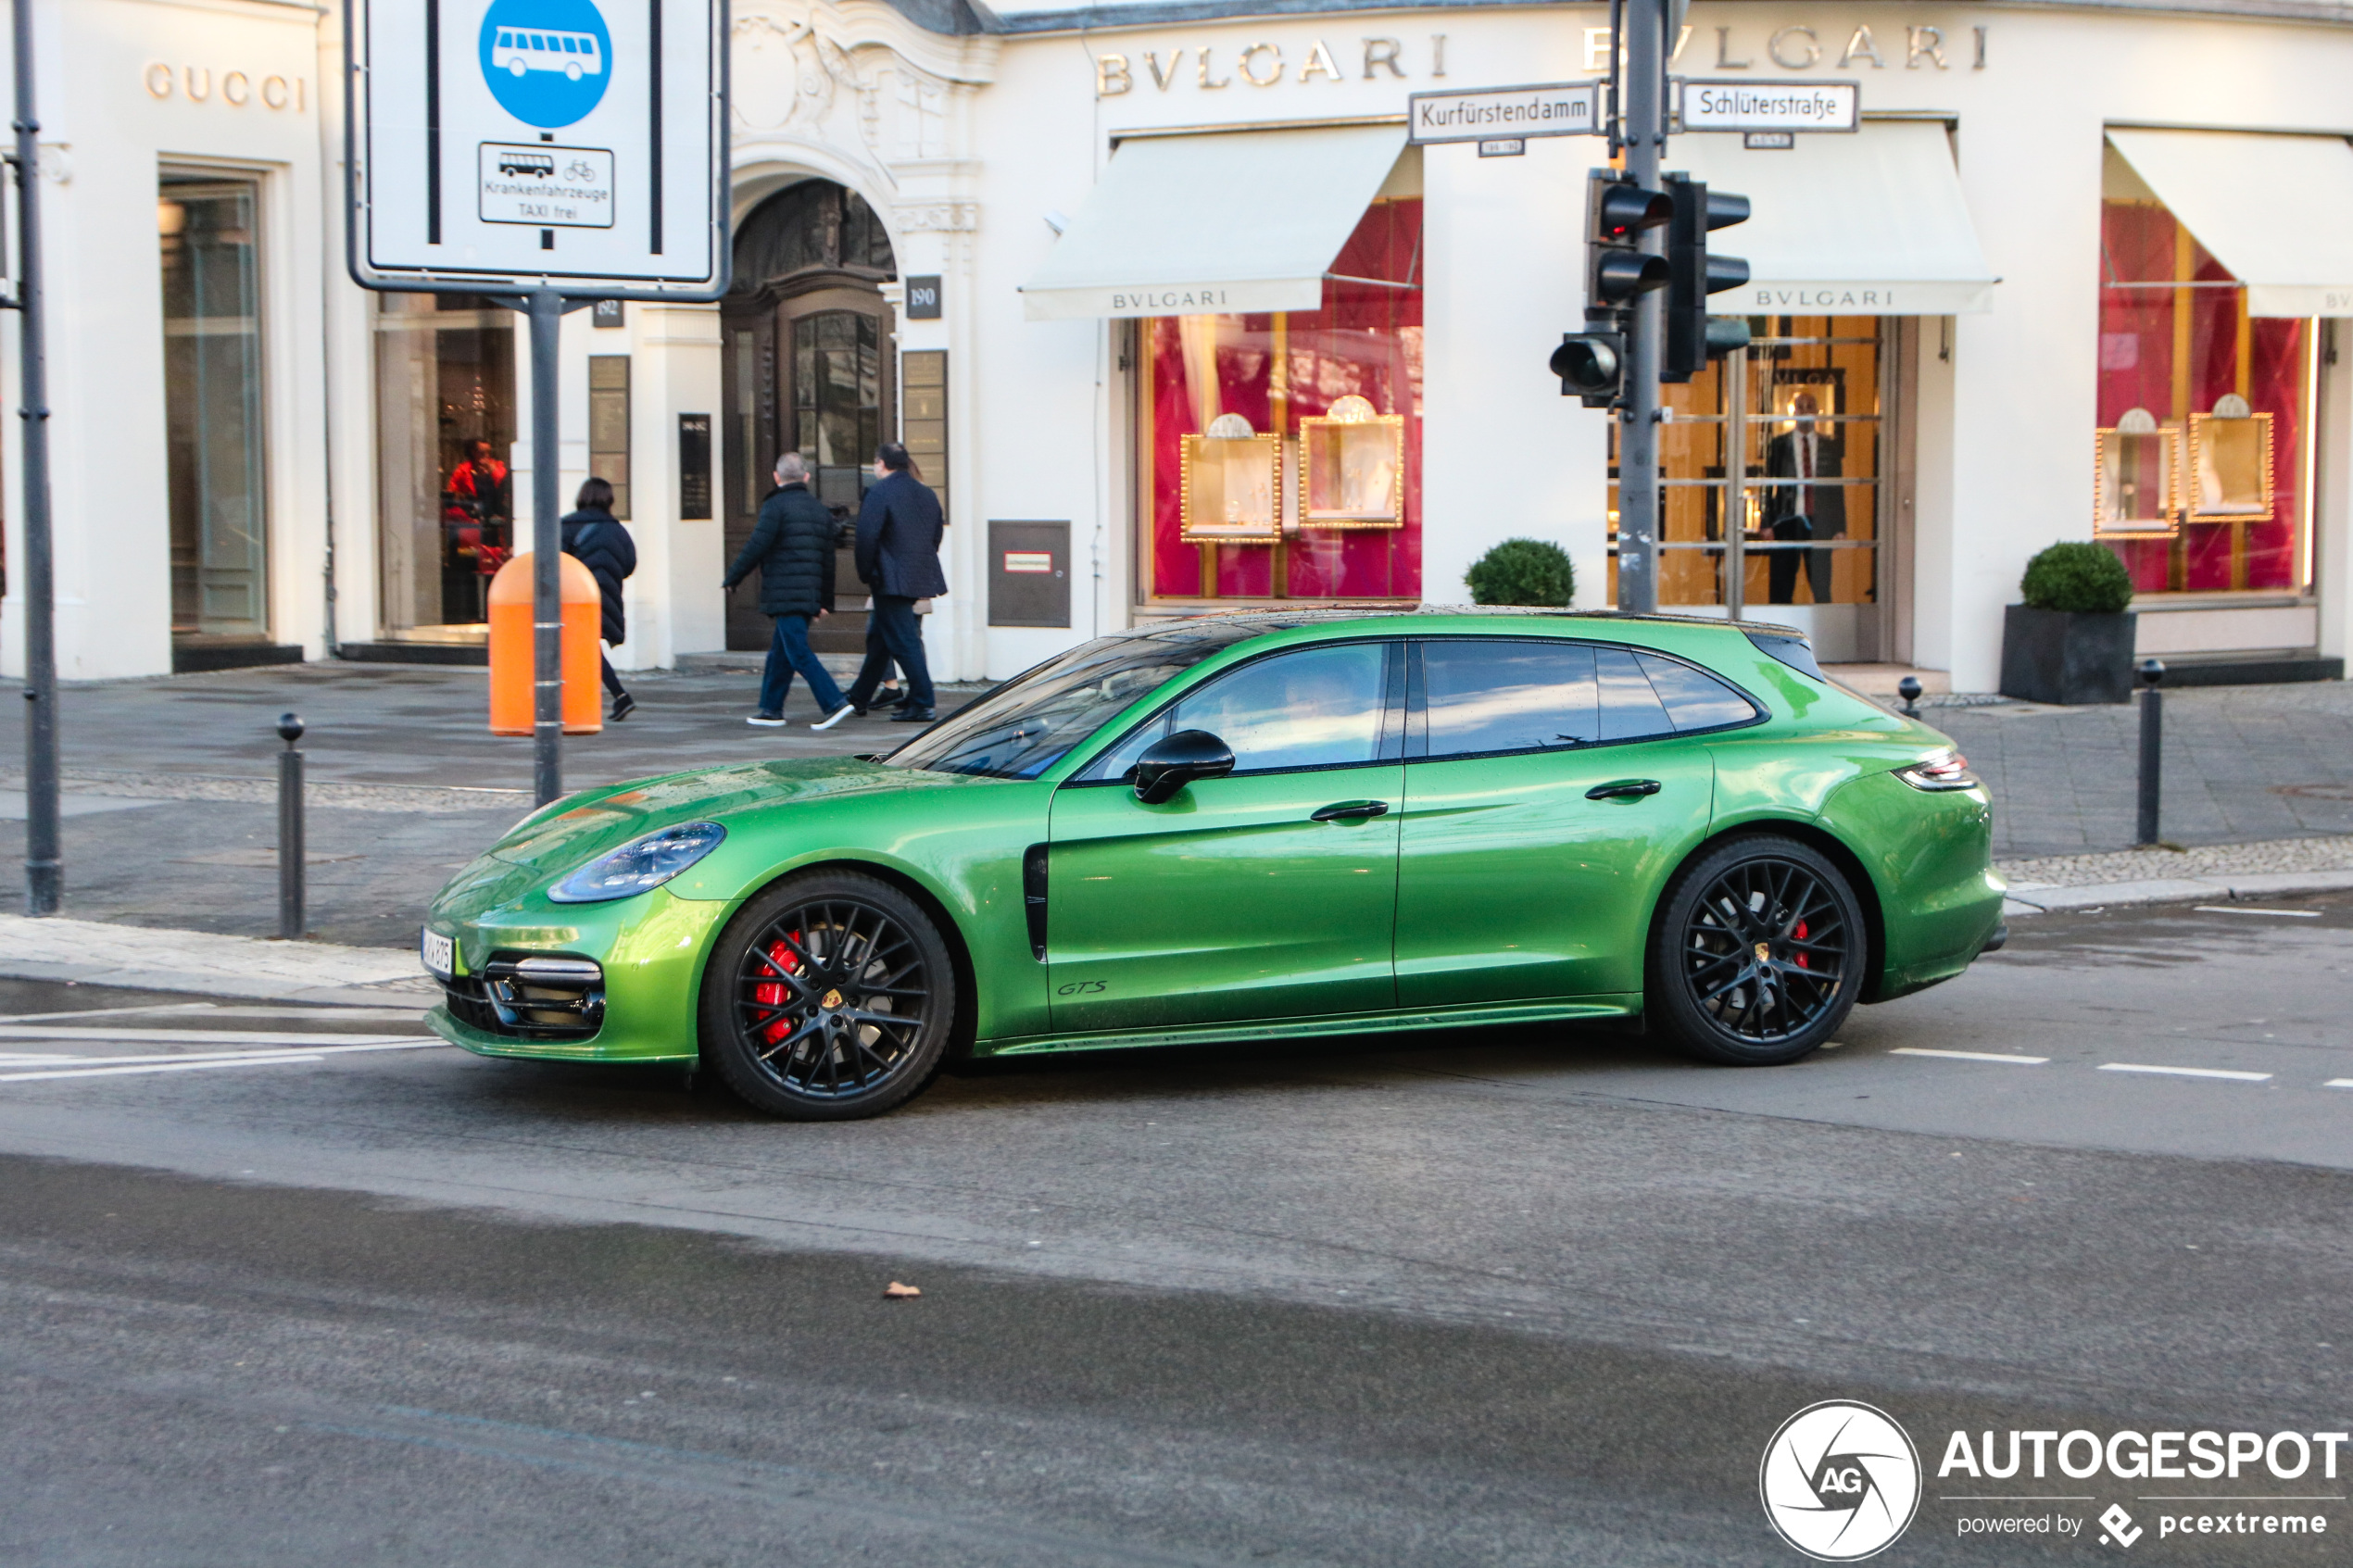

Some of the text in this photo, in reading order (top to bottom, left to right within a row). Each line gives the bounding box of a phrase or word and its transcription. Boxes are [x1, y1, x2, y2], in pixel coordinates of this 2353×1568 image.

[1096, 34, 1446, 95] BVLGARI
[145, 64, 305, 113] GUCCI
[1421, 97, 1587, 127] Kurfürstendamm
[1701, 90, 1836, 119] Schlüterstraße
[484, 180, 609, 203] Krankenfahrzeuge
[519, 203, 577, 219] TAXI frei
[911, 288, 937, 306] 190
[1113, 290, 1227, 308] BVLGARI
[1756, 291, 1892, 306] BVLGARI
[1058, 980, 1108, 996] GTS
